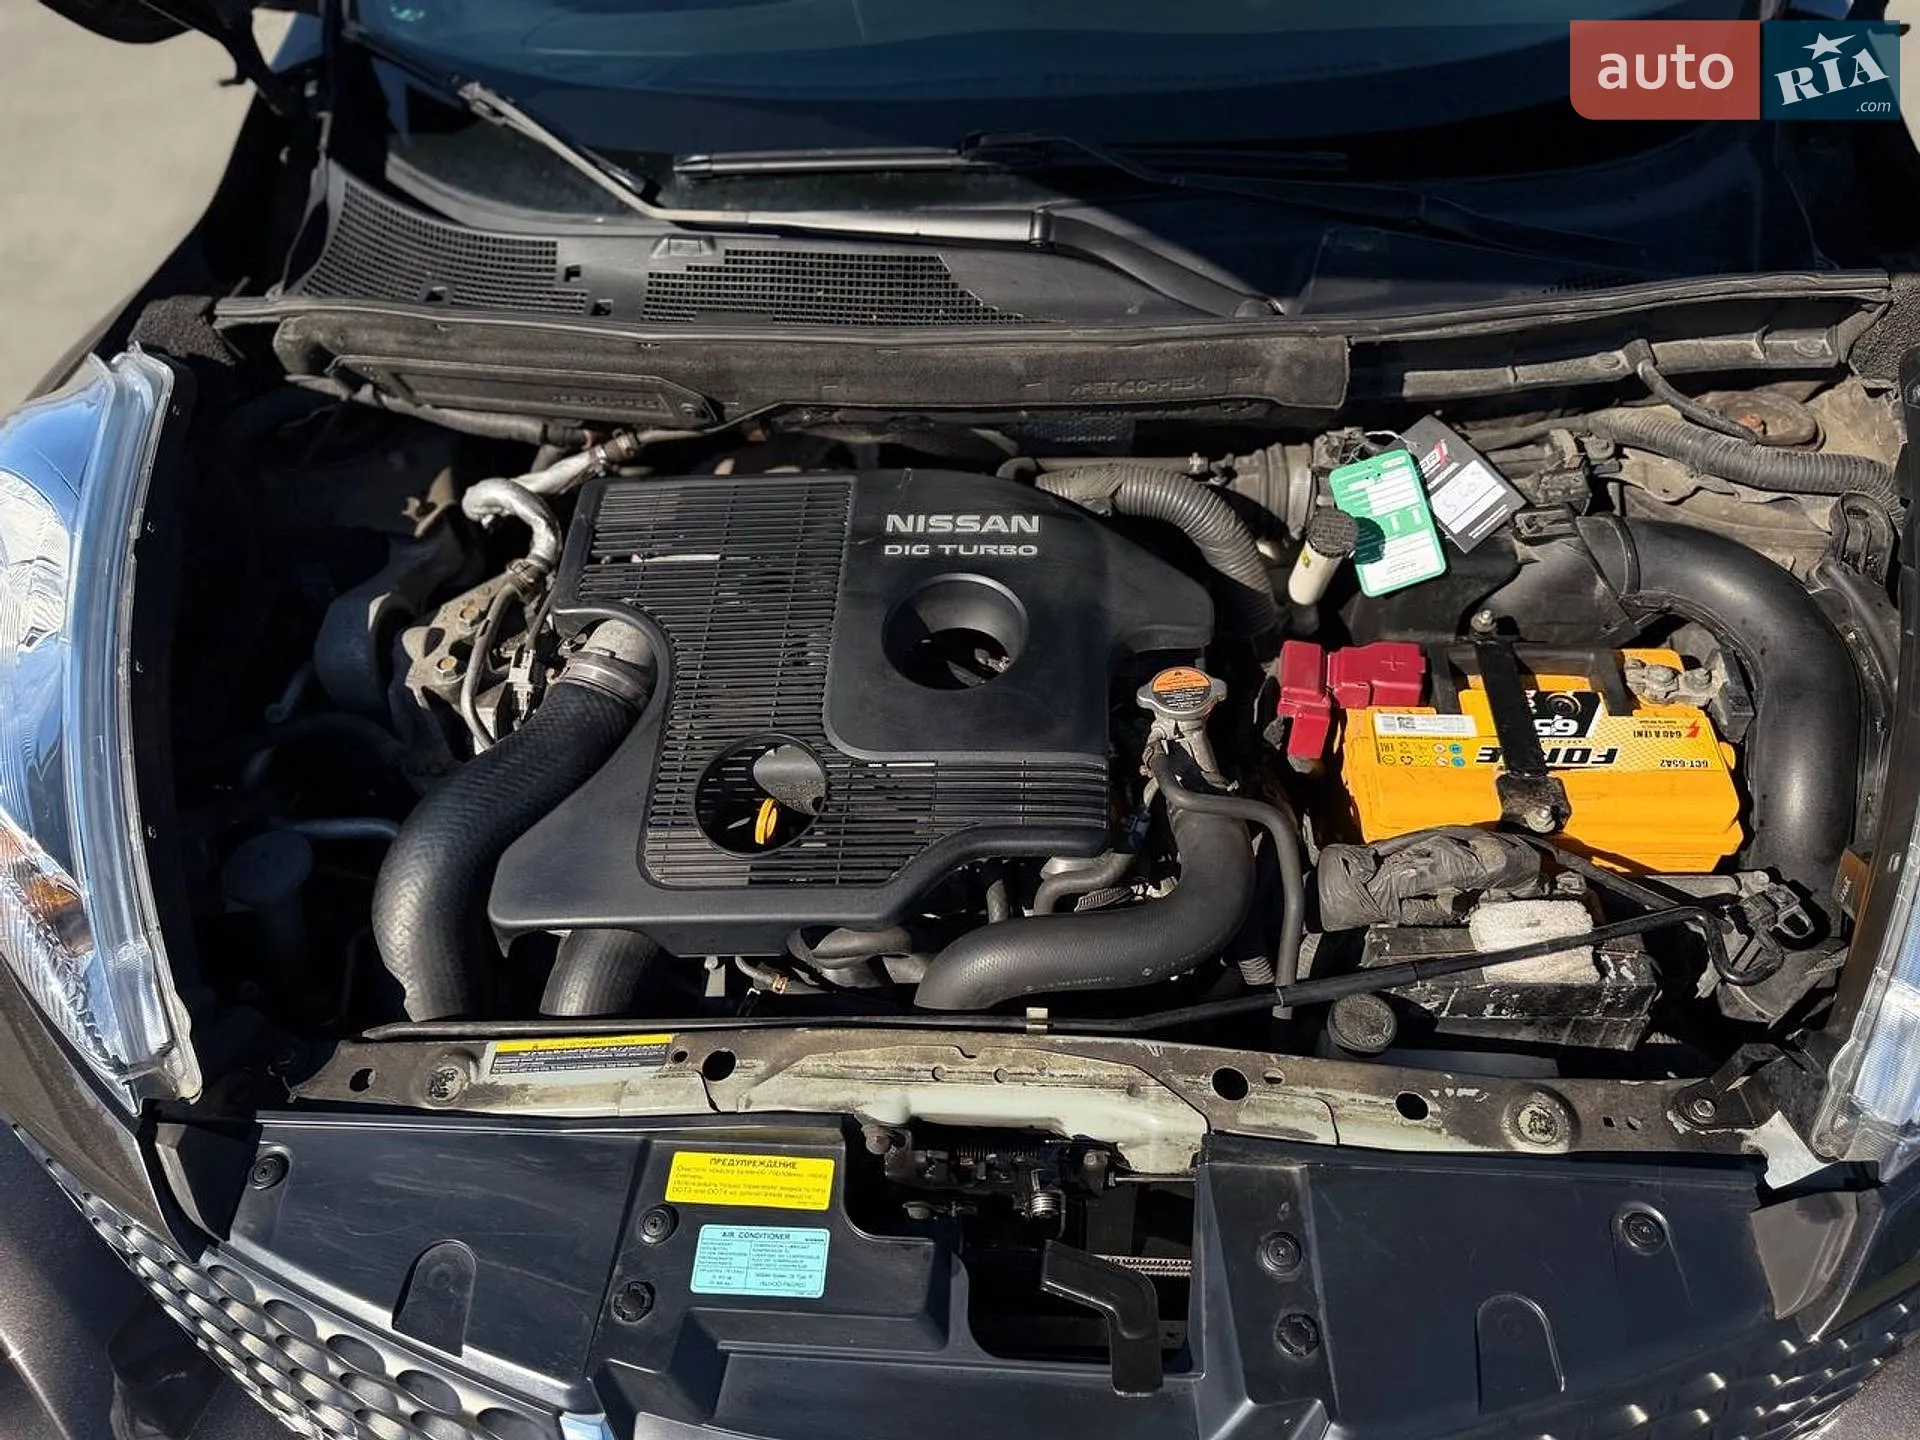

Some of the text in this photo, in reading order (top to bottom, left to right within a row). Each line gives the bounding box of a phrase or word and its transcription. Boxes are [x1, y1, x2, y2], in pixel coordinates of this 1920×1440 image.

[885, 514, 1039, 533] NISSAN
[884, 544, 1038, 555] DIG TURBO
[1476, 747, 1618, 764] FOE
[709, 1157, 798, 1170] ПРЕДУПРЕЖДЕНИЕ
[738, 1232, 791, 1241] CONDITIONER
